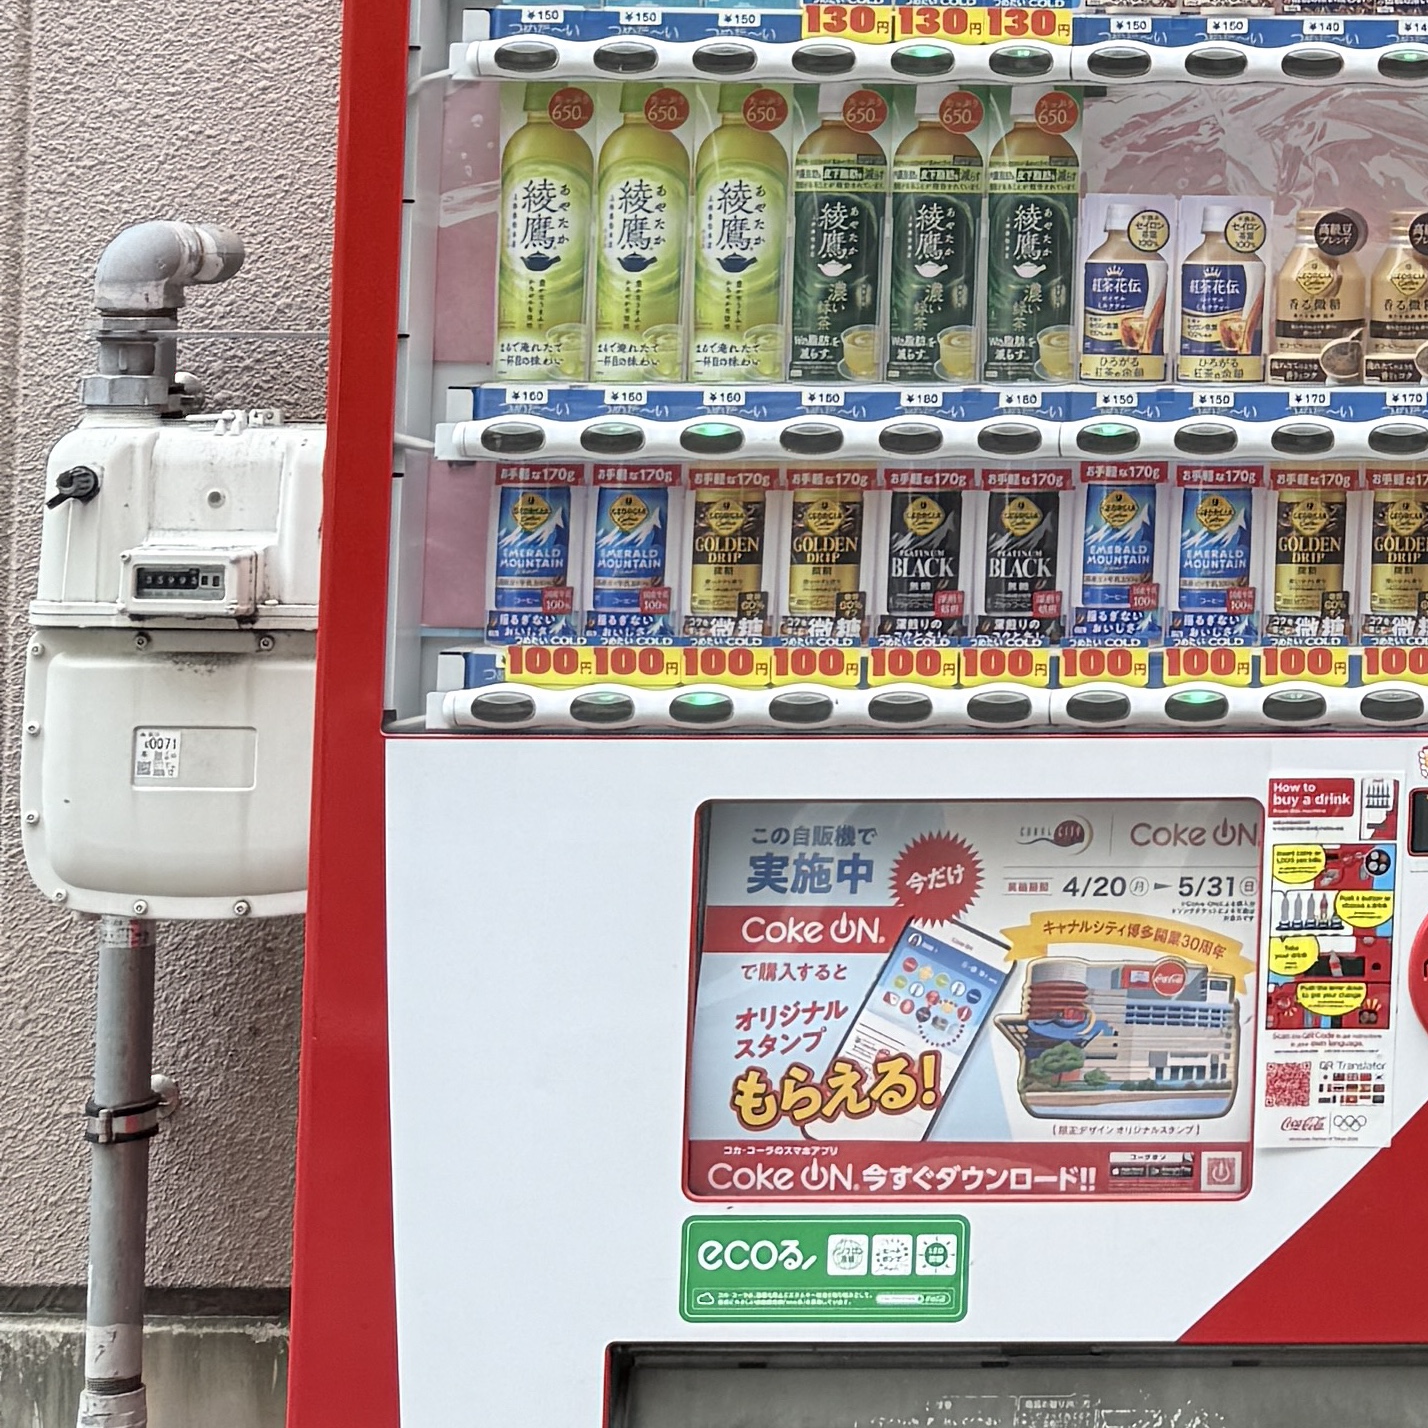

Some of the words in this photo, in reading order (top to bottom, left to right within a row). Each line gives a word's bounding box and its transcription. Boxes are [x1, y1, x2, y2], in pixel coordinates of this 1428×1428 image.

[806, 5, 890, 35] 130円
[899, 6, 982, 36] 130円
[988, 7, 1071, 37] 130円
[519, 178, 559, 251] 綾鷹
[616, 179, 657, 251] 綾鷹
[1092, 278, 1142, 294] 紅茶花伝
[1189, 279, 1240, 295] 紅茶花伝
[1289, 298, 1340, 311] 香る微糖
[1100, 357, 1140, 368] ひろがる
[1294, 393, 1326, 404] ¥170
[1391, 393, 1423, 404] ¥170
[503, 547, 561, 558] EMERALD
[695, 536, 759, 552] GOLDEN
[793, 536, 857, 552] GOLDEN
[1089, 545, 1148, 555] EMERALD
[1278, 536, 1342, 552] GOLDEN
[500, 558, 564, 569] MOUNTAIN
[707, 552, 742, 563] DRIP
[805, 552, 840, 563] DRIP
[891, 556, 954, 579] BLACK
[989, 556, 1052, 579] BLACK
[1087, 554, 1150, 565] MOUNTAIN
[508, 647, 592, 676] 100円
[594, 647, 679, 676] 100円
[683, 647, 768, 677] 100円
[774, 648, 858, 677] 100円
[1273, 782, 1301, 793] How
[1303, 782, 1316, 793] to
[1273, 793, 1299, 807] buy
[1303, 796, 1311, 805] a
[1314, 793, 1352, 806] drink
[751, 825, 877, 847] この自販機で
[1130, 822, 1207, 847] Coke
[1212, 816, 1258, 847] ON
[748, 853, 874, 895] 実施中
[905, 865, 966, 895] 今だけ
[1043, 917, 1228, 960] キャナルシティ博多開業30周年
[740, 962, 848, 983] で購入すると
[734, 1002, 848, 1033] オリジナル
[734, 1028, 825, 1059] スタンプ
[731, 1051, 941, 1132] もらえる!
[723, 1145, 838, 1156] コカ・コーラのスマホアプリ
[707, 1162, 794, 1193] Coke
[863, 1165, 1096, 1193] 今すぐダウンロード!!
